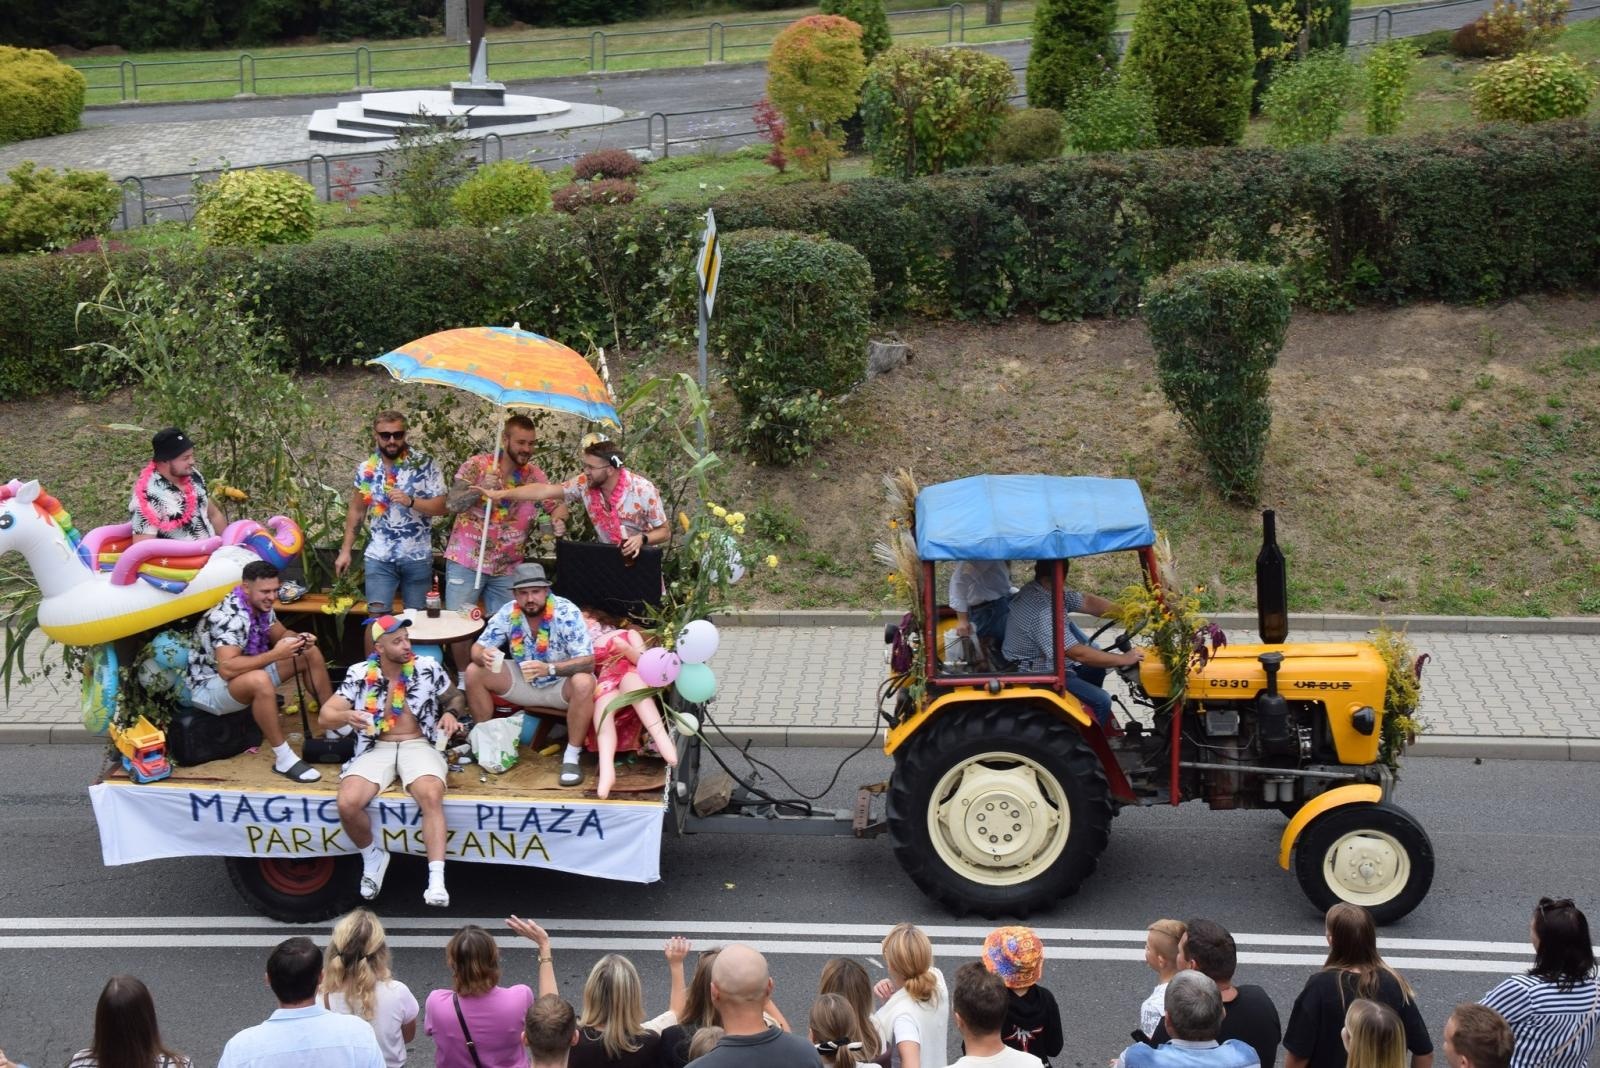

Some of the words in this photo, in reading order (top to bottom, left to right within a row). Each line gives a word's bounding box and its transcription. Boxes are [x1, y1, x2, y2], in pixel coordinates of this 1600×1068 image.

[1294, 681, 1352, 690] URSUS
[476, 803, 604, 840] PLAŻA
[246, 825, 346, 853] PARK
